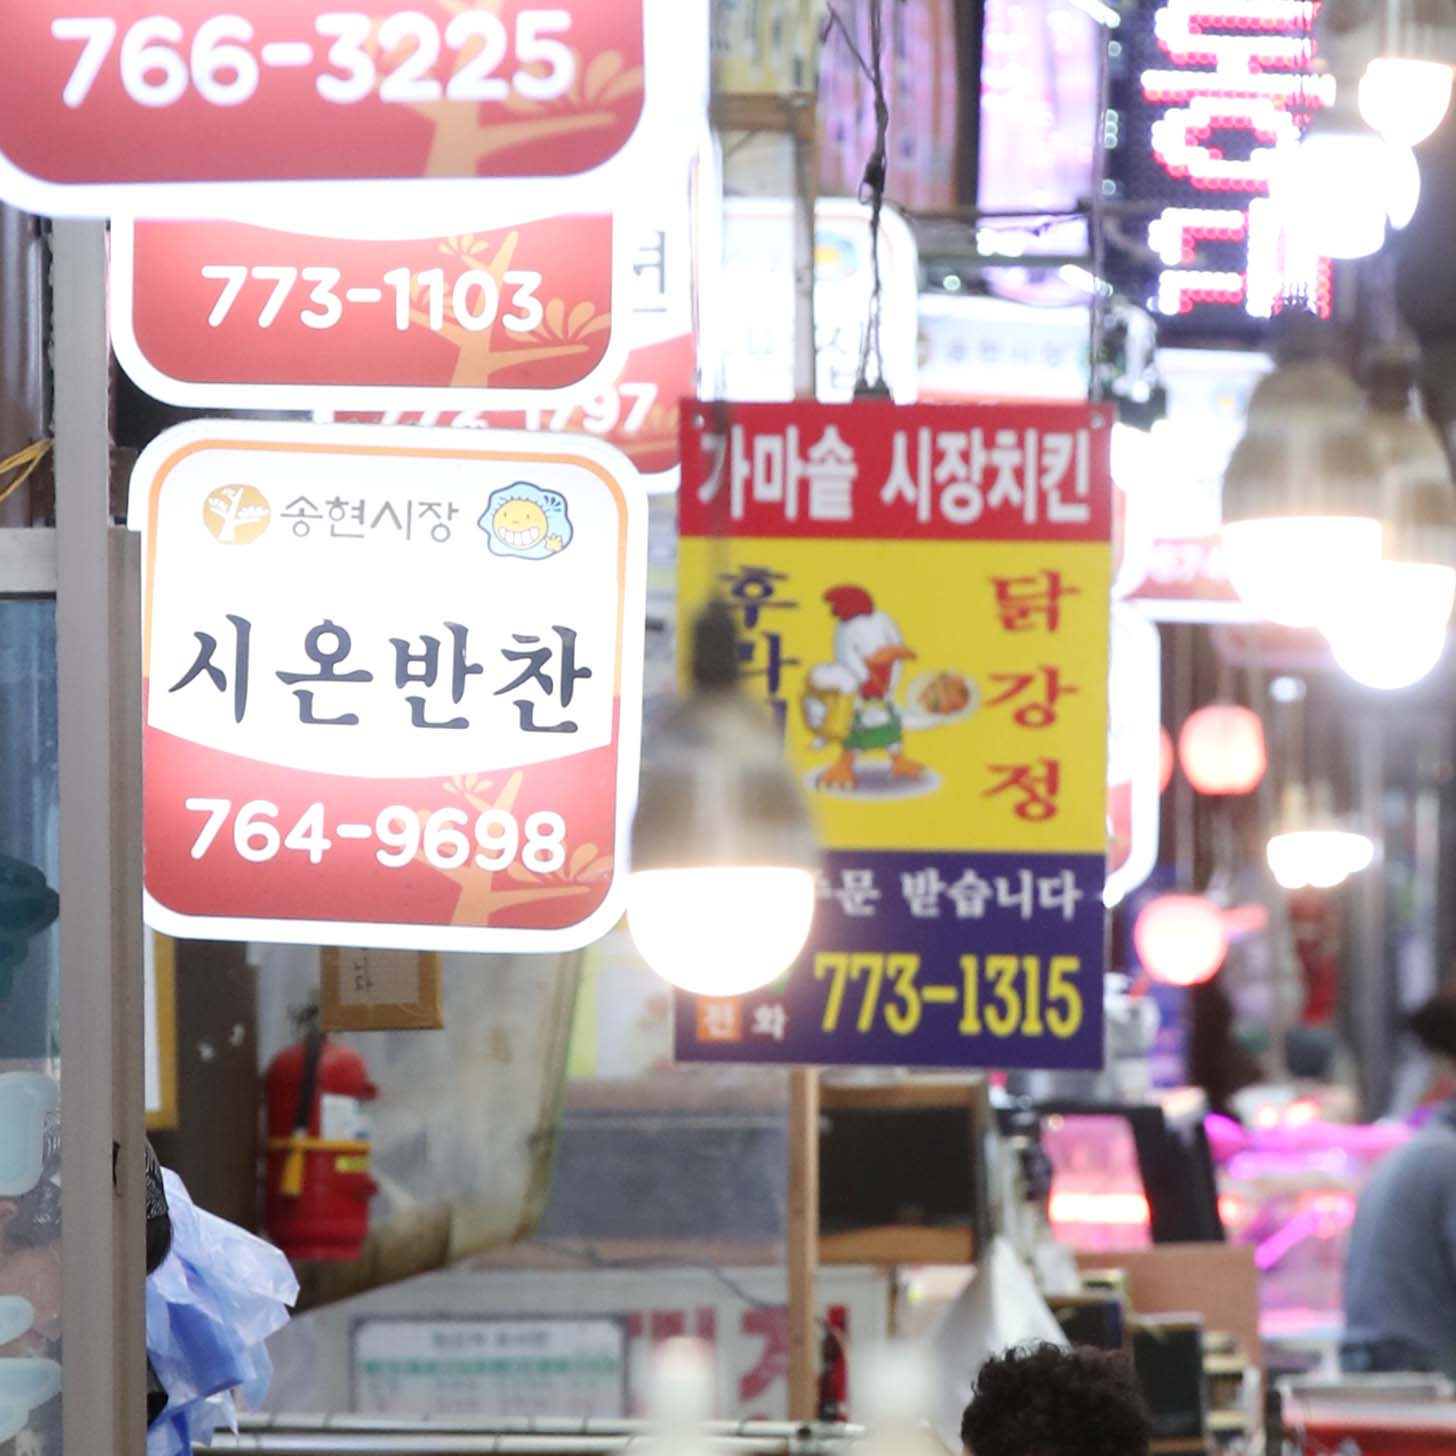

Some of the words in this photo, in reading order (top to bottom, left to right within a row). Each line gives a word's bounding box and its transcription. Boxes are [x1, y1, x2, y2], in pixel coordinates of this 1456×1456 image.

[51, 10, 575, 108] 766-3225
[201, 264, 545, 332] 773-1103
[279, 495, 460, 544] 송현시장
[880, 426, 1092, 524] 시장치킨
[168, 613, 593, 735] 시온반찬
[984, 568, 1082, 823] 닭강정
[184, 797, 567, 873] 764-9698
[900, 867, 1083, 922] 받습니다
[814, 950, 1084, 1039] 773-1315
